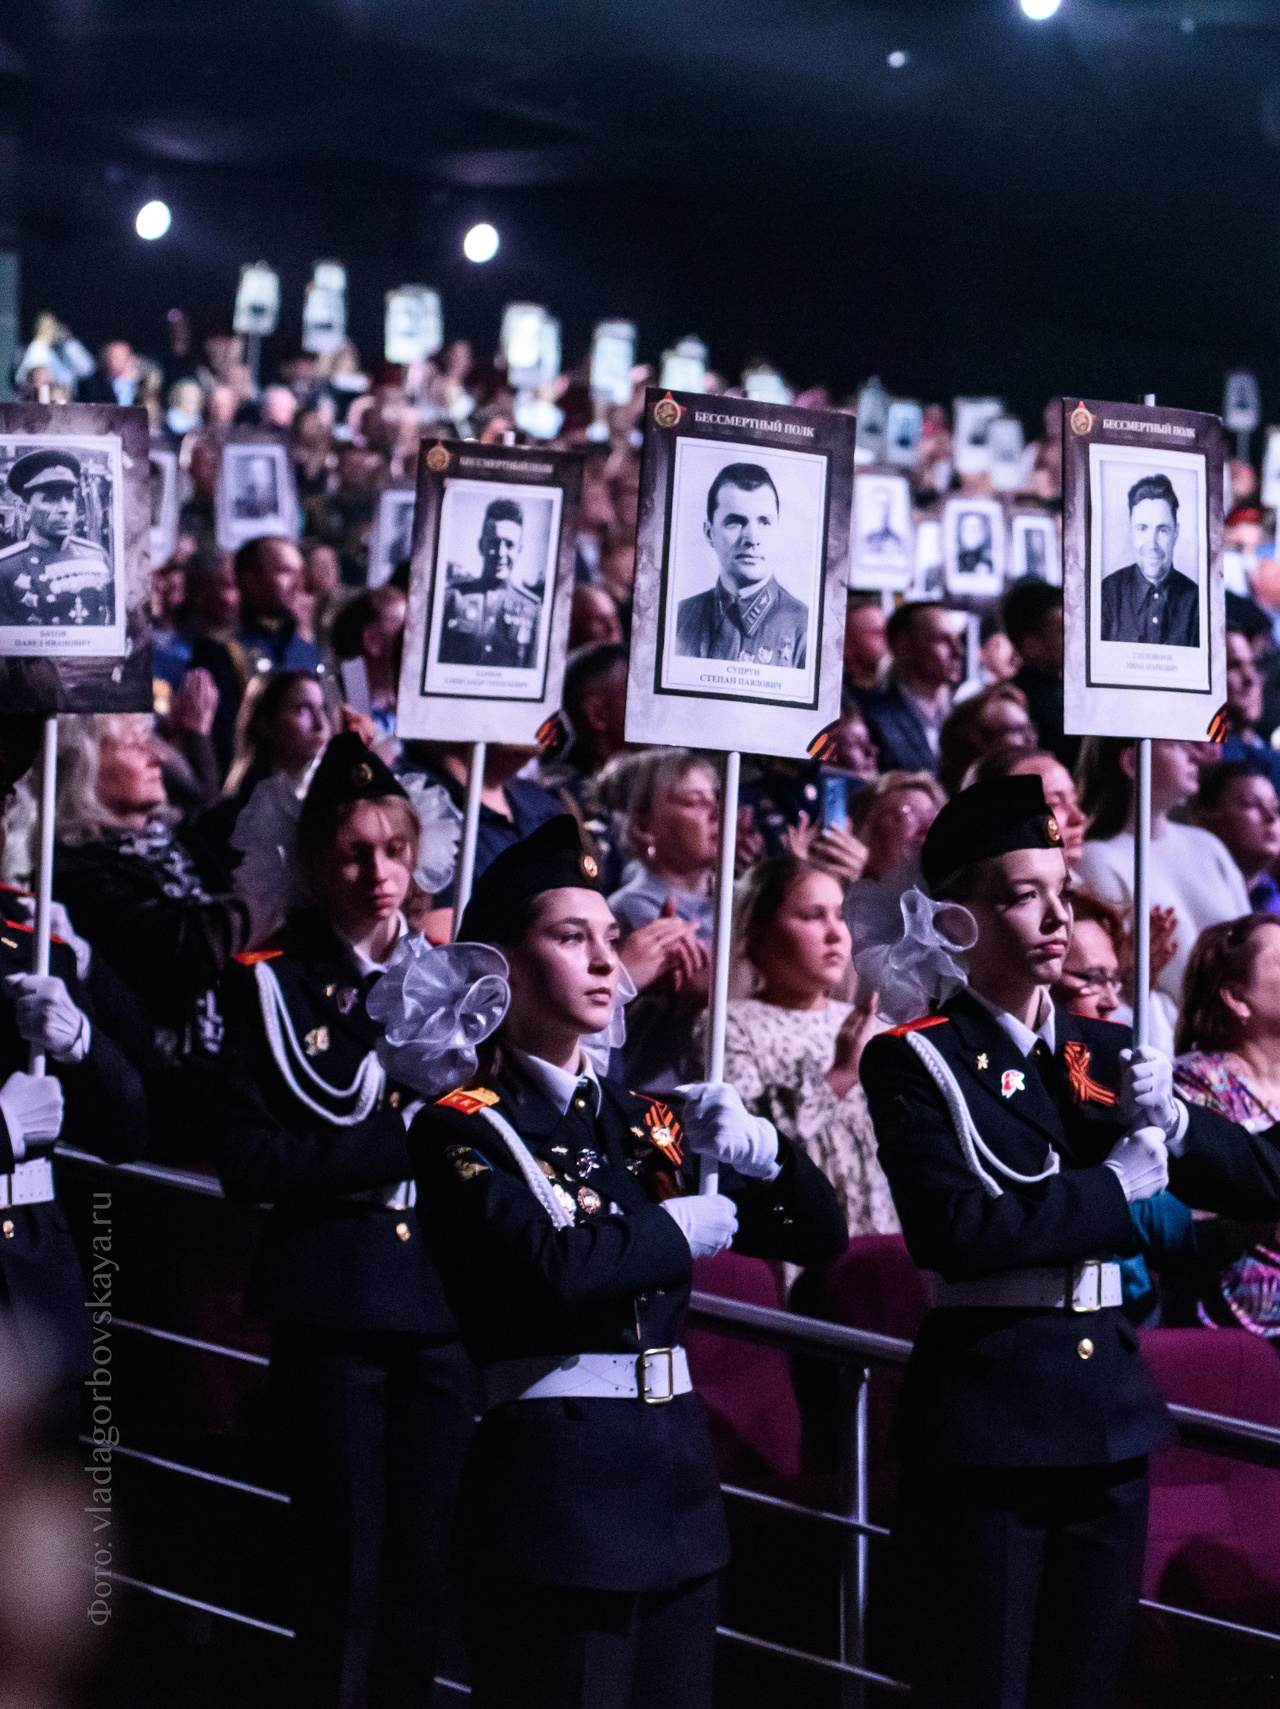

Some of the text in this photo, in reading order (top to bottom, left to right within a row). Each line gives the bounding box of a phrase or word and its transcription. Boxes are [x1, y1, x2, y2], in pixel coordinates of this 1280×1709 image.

[695, 411, 815, 437] БЕССМЕРТНЫЙ ПОЛК
[1103, 419, 1196, 438] БЕССМЕРТНЫЙ ПОЛК
[726, 665, 760, 677] СУПРУН
[699, 674, 782, 690] СТЕПАН ПАВЛОВИЧ
